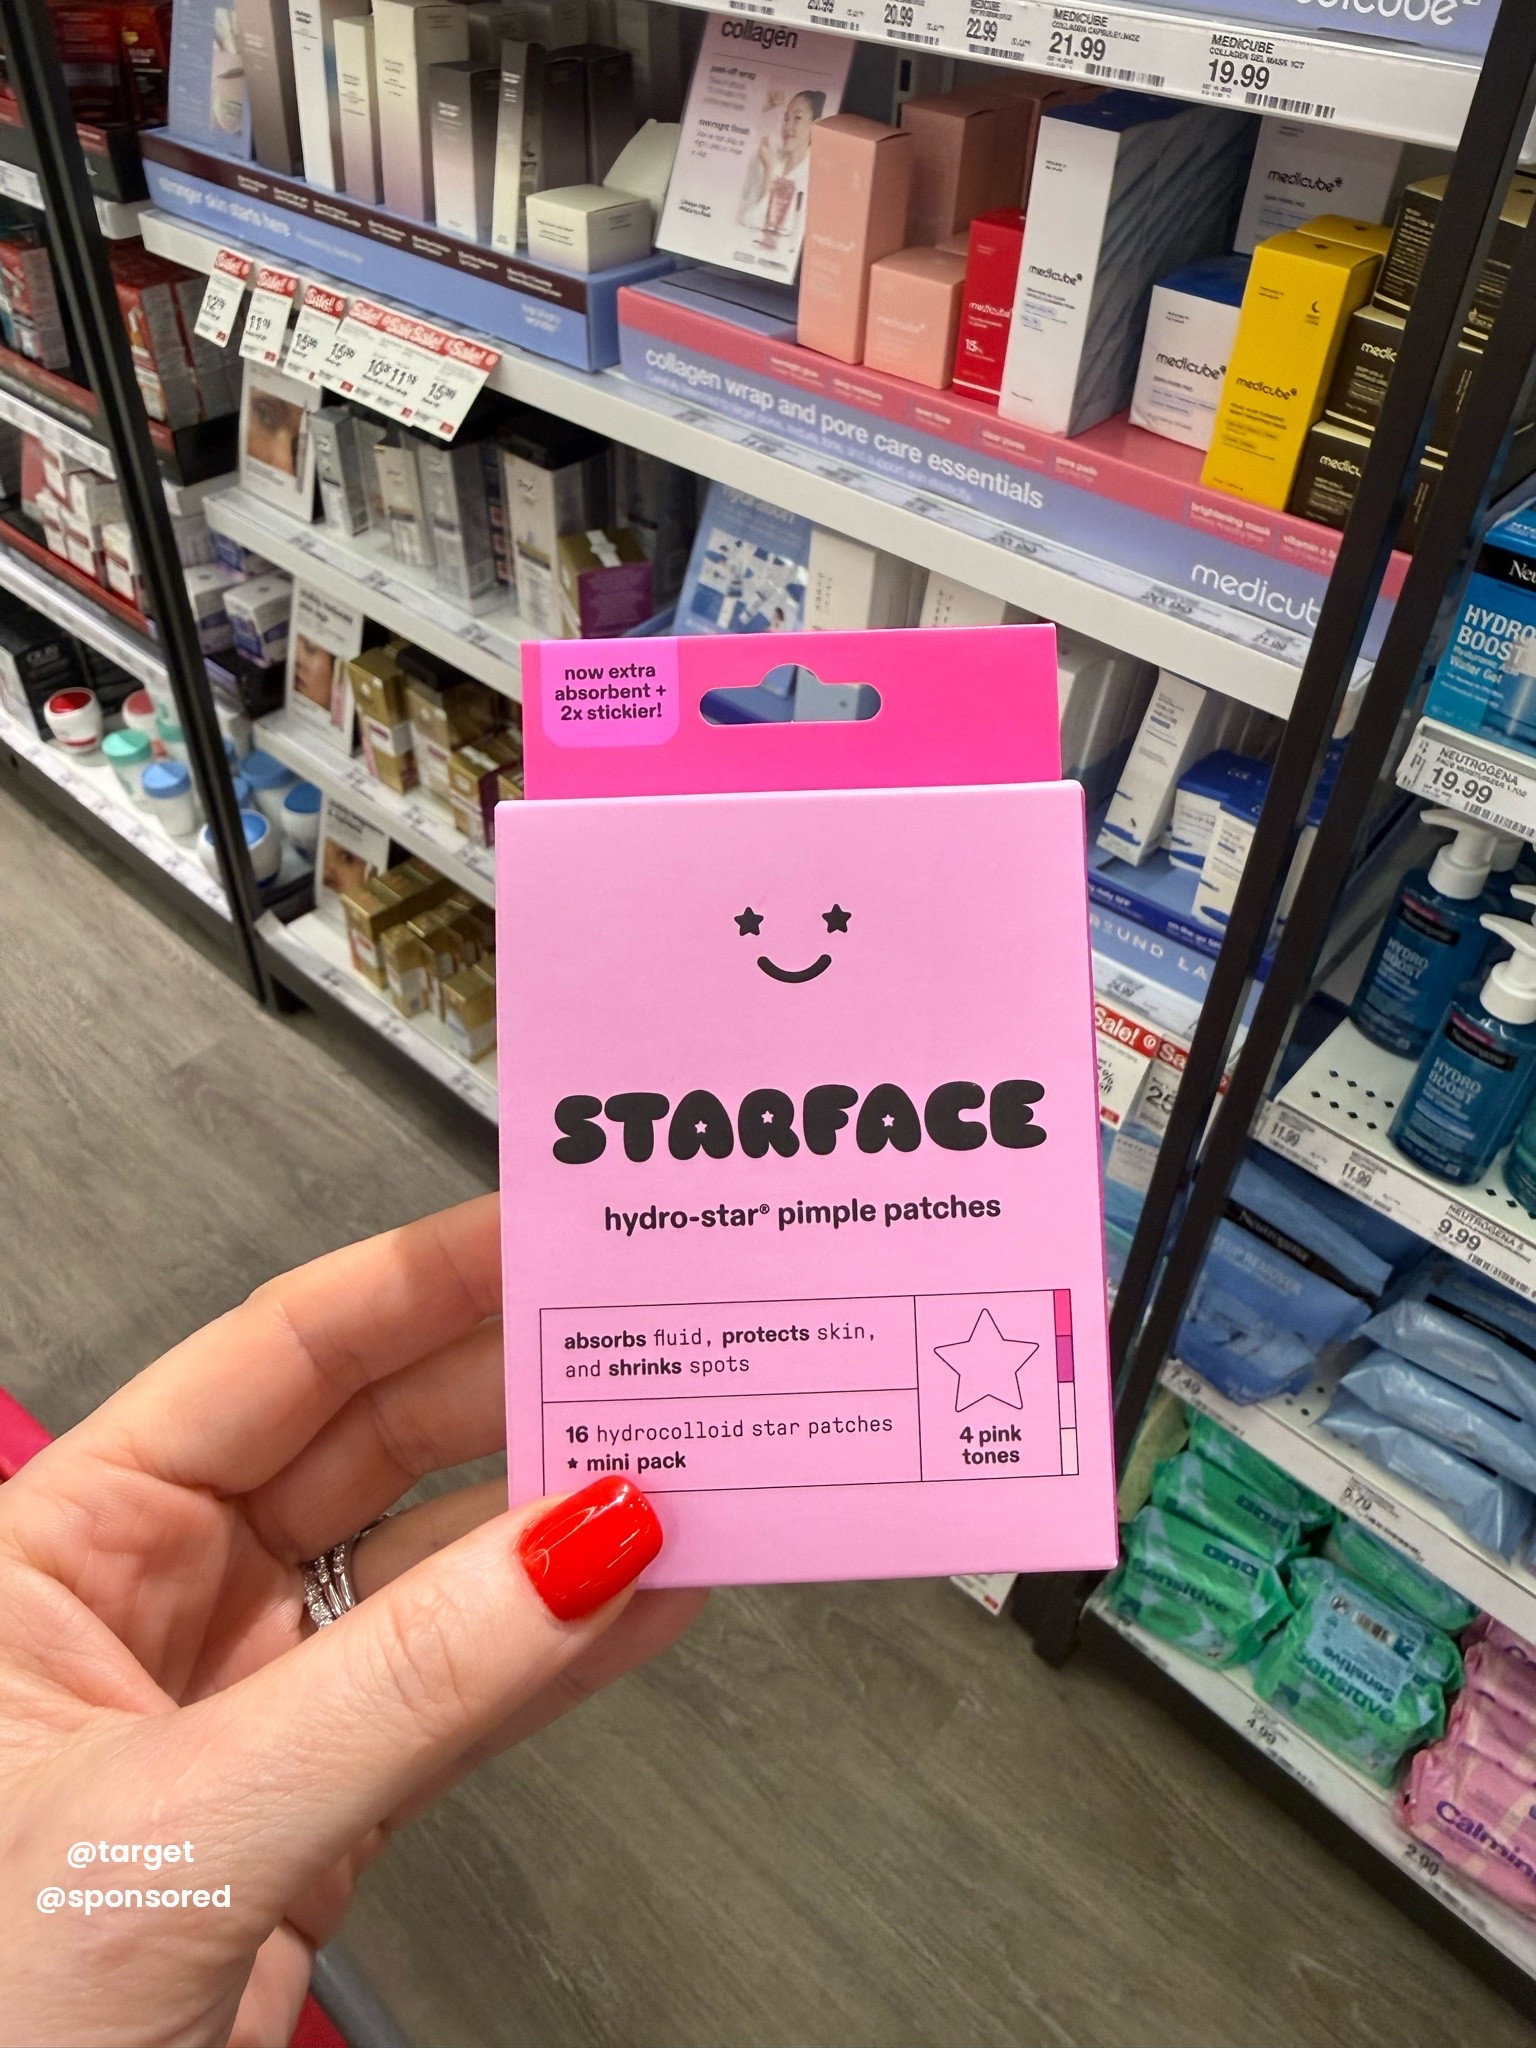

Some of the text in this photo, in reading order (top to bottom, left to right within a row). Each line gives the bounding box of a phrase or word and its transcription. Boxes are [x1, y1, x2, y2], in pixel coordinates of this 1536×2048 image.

[885, 4, 914, 27] 20.99
[966, 17, 998, 42] 22.99
[1053, 8, 1110, 27] MEDICUBE
[721, 20, 798, 49] collagen
[1049, 31, 1107, 61] 21.99
[1211, 34, 1276, 54] MEDICUBE
[1208, 58, 1270, 90] 19.99
[1268, 169, 1335, 193] medicube
[1156, 351, 1220, 380] medicube
[1236, 376, 1290, 400] medicube
[646, 349, 722, 390] collagen
[724, 378, 775, 411] wrap
[778, 398, 817, 425] and
[820, 414, 869, 444] pore
[873, 433, 923, 464] care
[927, 452, 1044, 510] essentials
[1464, 604, 1536, 645] HYDRO
[1457, 625, 1525, 665] BOOST
[565, 663, 656, 681] now extra
[555, 683, 667, 701] absorbent +
[561, 702, 663, 721] 2x stickier!
[1438, 747, 1519, 787] NEUTROGENA
[1431, 766, 1494, 805] 19.99
[1428, 1070, 1478, 1105] BOOST
[1433, 1057, 1482, 1095] HYDRO
[553, 1079, 1047, 1164] STARFACE
[1271, 1121, 1301, 1147] 11.99
[1341, 1162, 1373, 1189] 11.99
[604, 1194, 1001, 1237] hydro-star® pimple patches
[1448, 1203, 1517, 1246] NEUTROGENA
[1438, 1217, 1482, 1252] 9.99
[564, 1322, 876, 1350] absorbs fluid, protects skin,
[565, 1356, 750, 1378] and shrinks spots
[565, 1415, 893, 1446] 16 hydrocolloid star patches
[959, 1424, 1022, 1447] 4 pink
[587, 1451, 687, 1474] mini pack
[962, 1448, 1020, 1465] tones
[1436, 1799, 1536, 1886] Calmin
